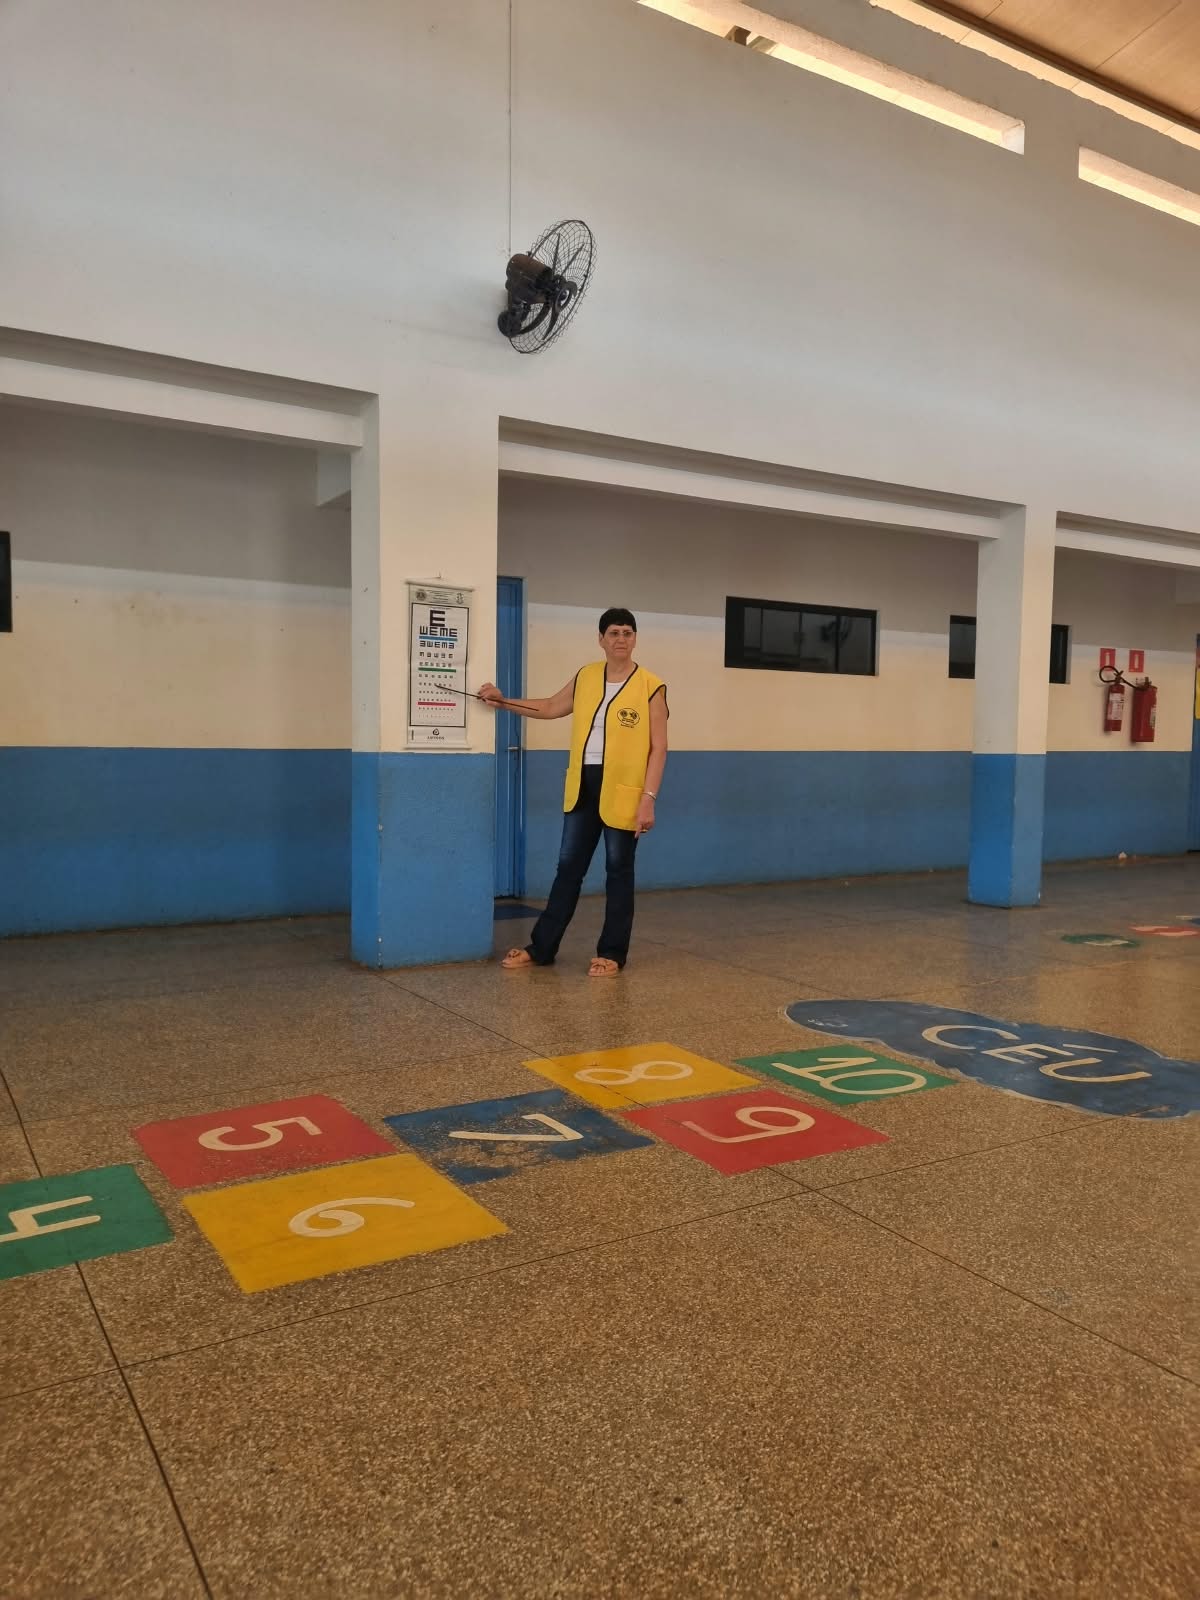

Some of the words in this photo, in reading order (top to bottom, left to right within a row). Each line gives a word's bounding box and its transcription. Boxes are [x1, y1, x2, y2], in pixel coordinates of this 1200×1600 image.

[574, 1060, 694, 1086] 8
[771, 1056, 927, 1095] 10
[198, 1116, 323, 1151] 5
[448, 1113, 583, 1142] 7
[681, 1106, 816, 1144] 9
[288, 1197, 415, 1238] 6
